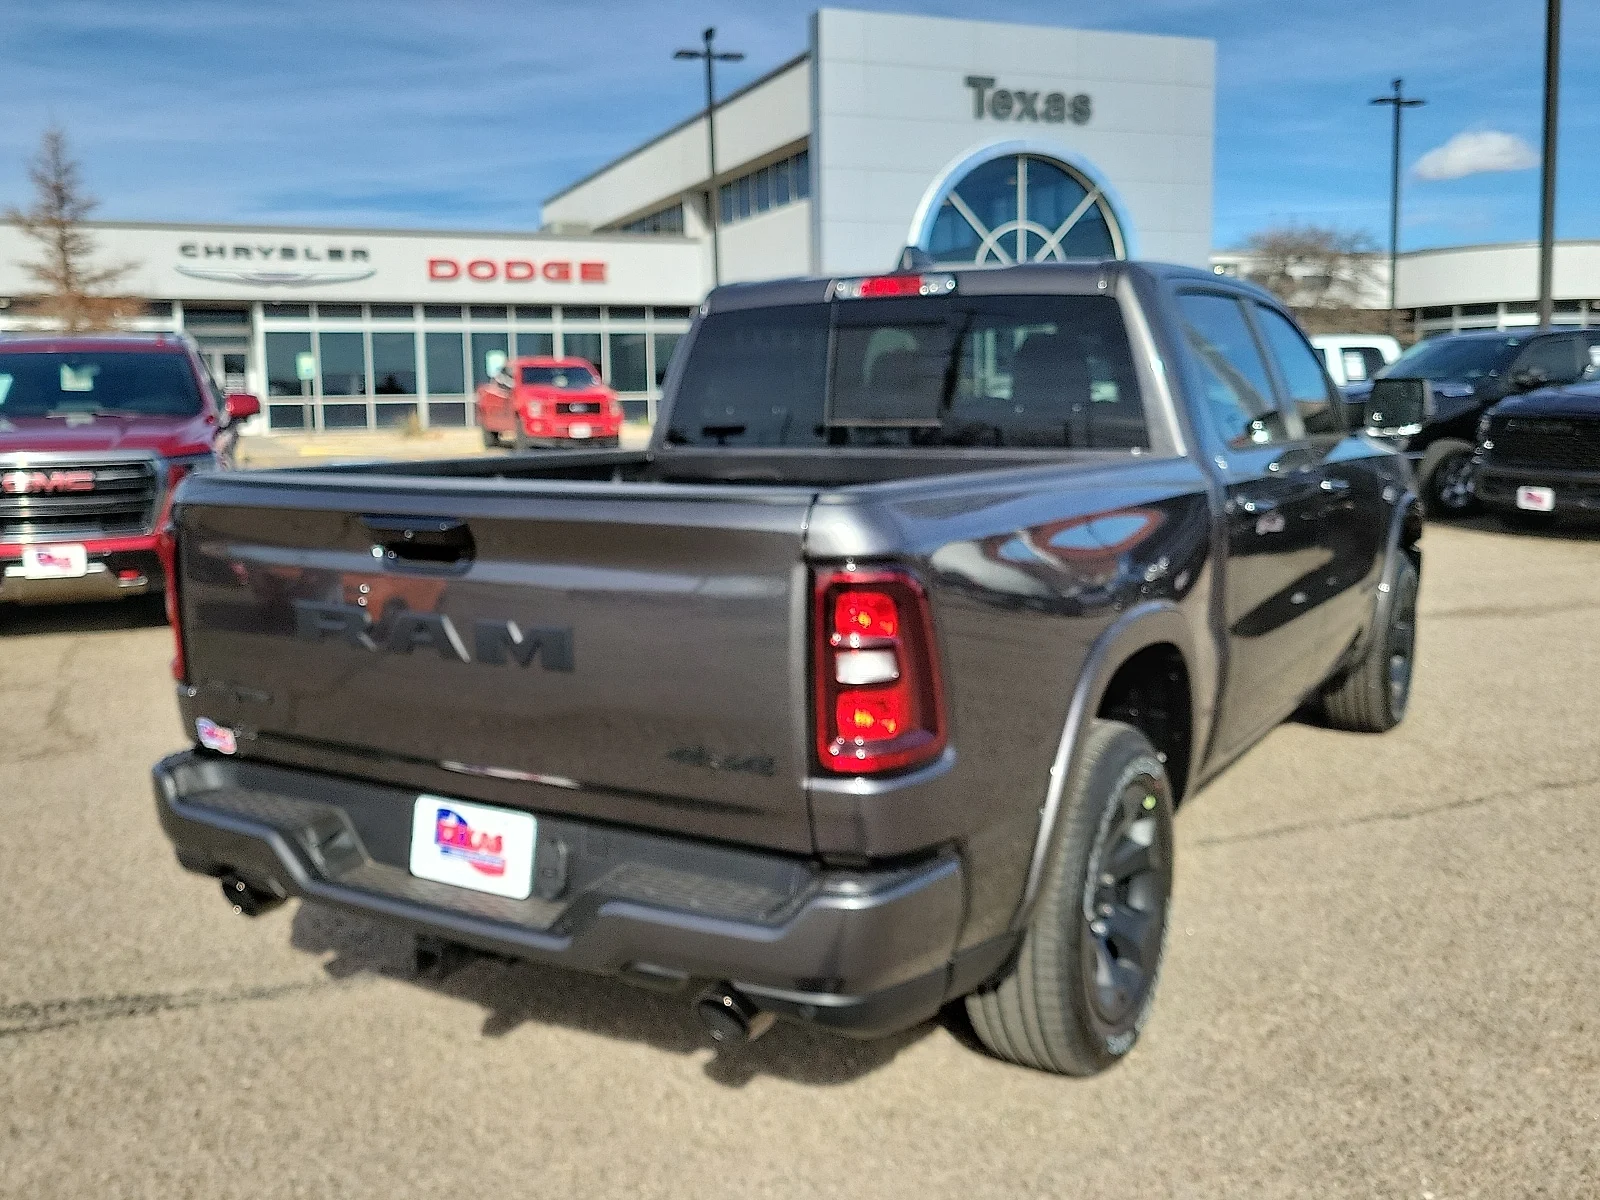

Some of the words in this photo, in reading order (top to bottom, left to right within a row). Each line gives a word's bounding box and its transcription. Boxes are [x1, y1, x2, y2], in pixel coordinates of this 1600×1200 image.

[964, 75, 1092, 126] Texas
[178, 243, 370, 261] CHRYSLER
[428, 258, 606, 283] DODGE
[1, 470, 95, 494] GMC
[293, 599, 575, 672] RAM
